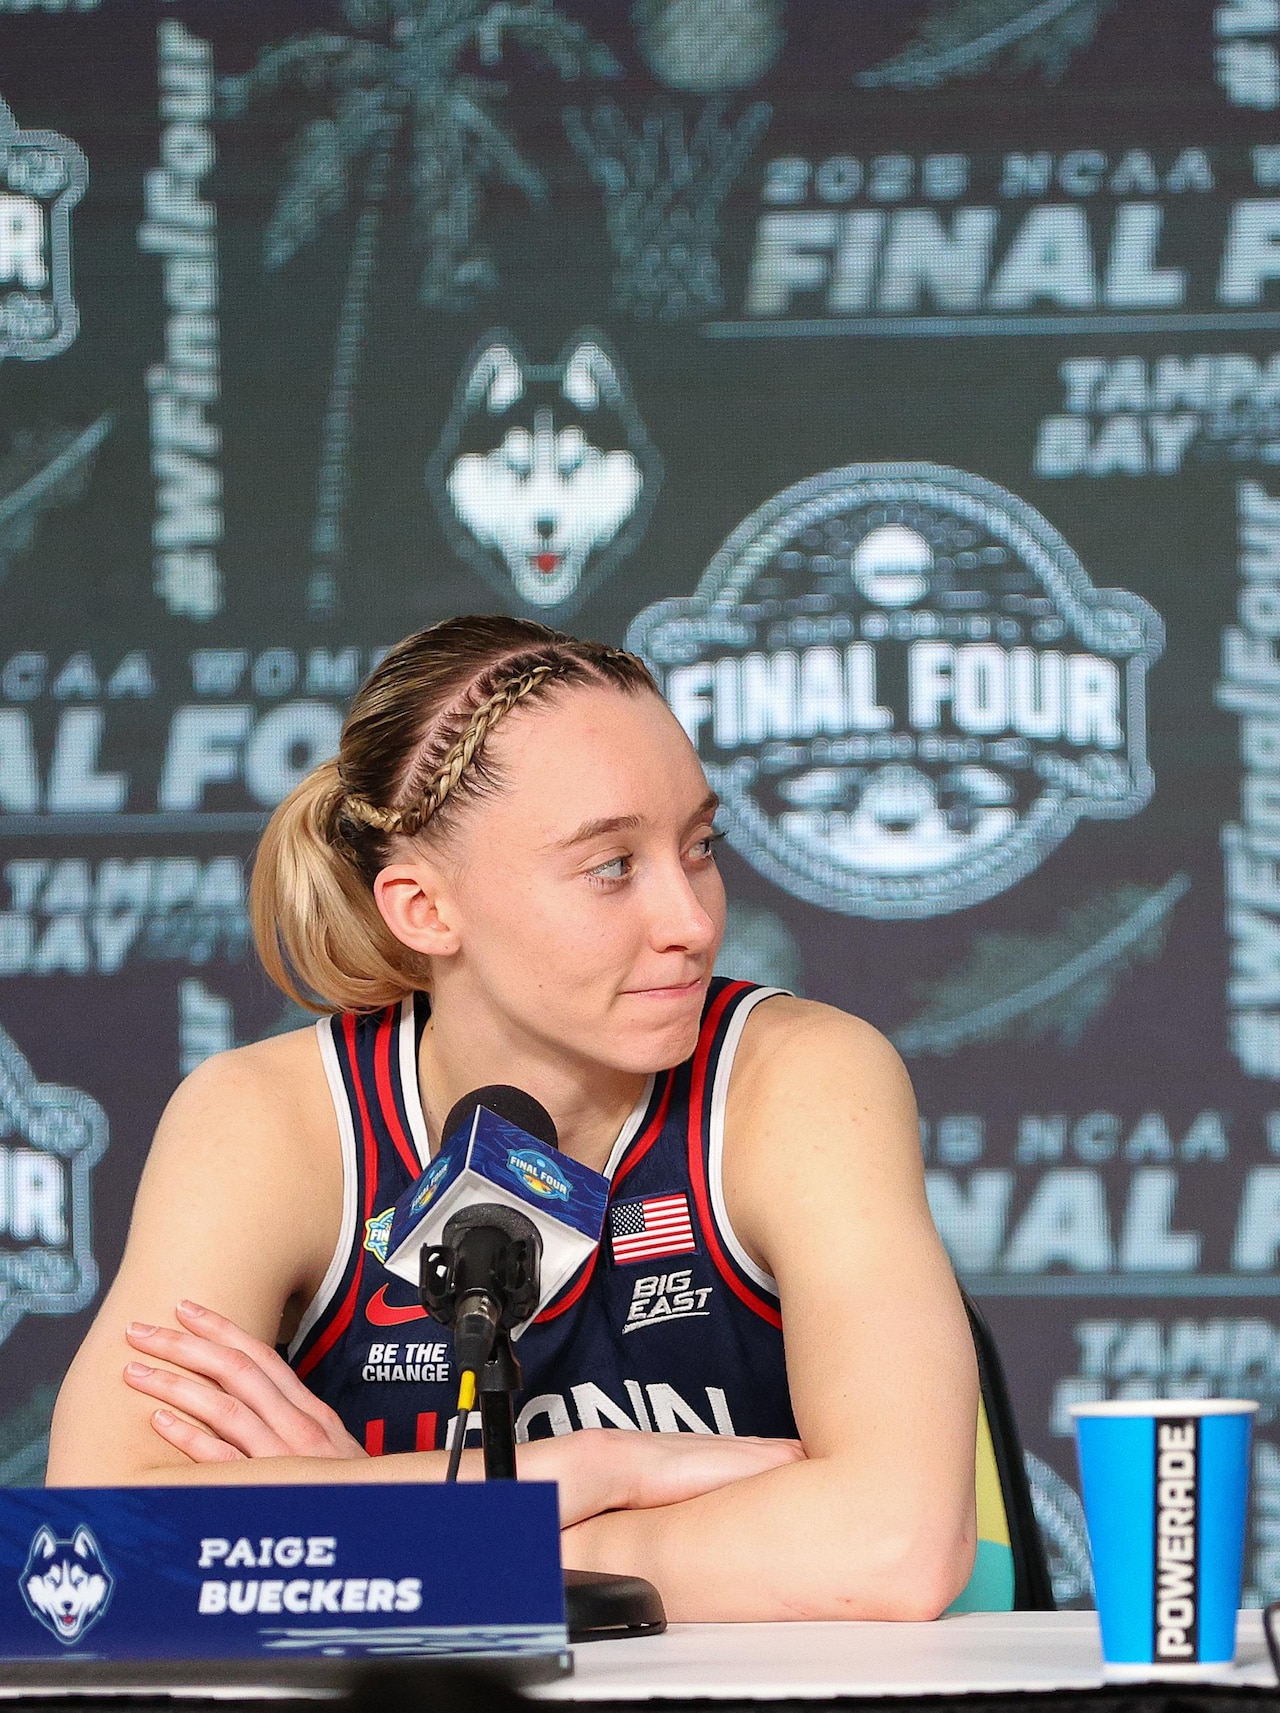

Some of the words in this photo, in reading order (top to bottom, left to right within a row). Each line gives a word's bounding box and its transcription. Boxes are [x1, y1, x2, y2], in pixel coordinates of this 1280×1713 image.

[1002, 146, 1216, 197] NCAA
[743, 200, 1190, 316] FINAL
[1033, 412, 1201, 478] BAY
[666, 639, 895, 756] FINAL
[907, 638, 1126, 751] FOUR
[3, 855, 247, 914] TAMPA
[1015, 1108, 1230, 1166] NCAA
[510, 1155, 540, 1178] FINAL
[540, 1171, 568, 1195] FOUR
[626, 1287, 714, 1322] EAST
[632, 1269, 693, 1301] BIG
[361, 1362, 449, 1383] CHANGE
[368, 1342, 400, 1364] BE
[404, 1342, 448, 1364] THE
[198, 1536, 337, 1569] PAIGE
[1156, 1422, 1197, 1658] POWERADE
[198, 1577, 422, 1615] BUECKERS
